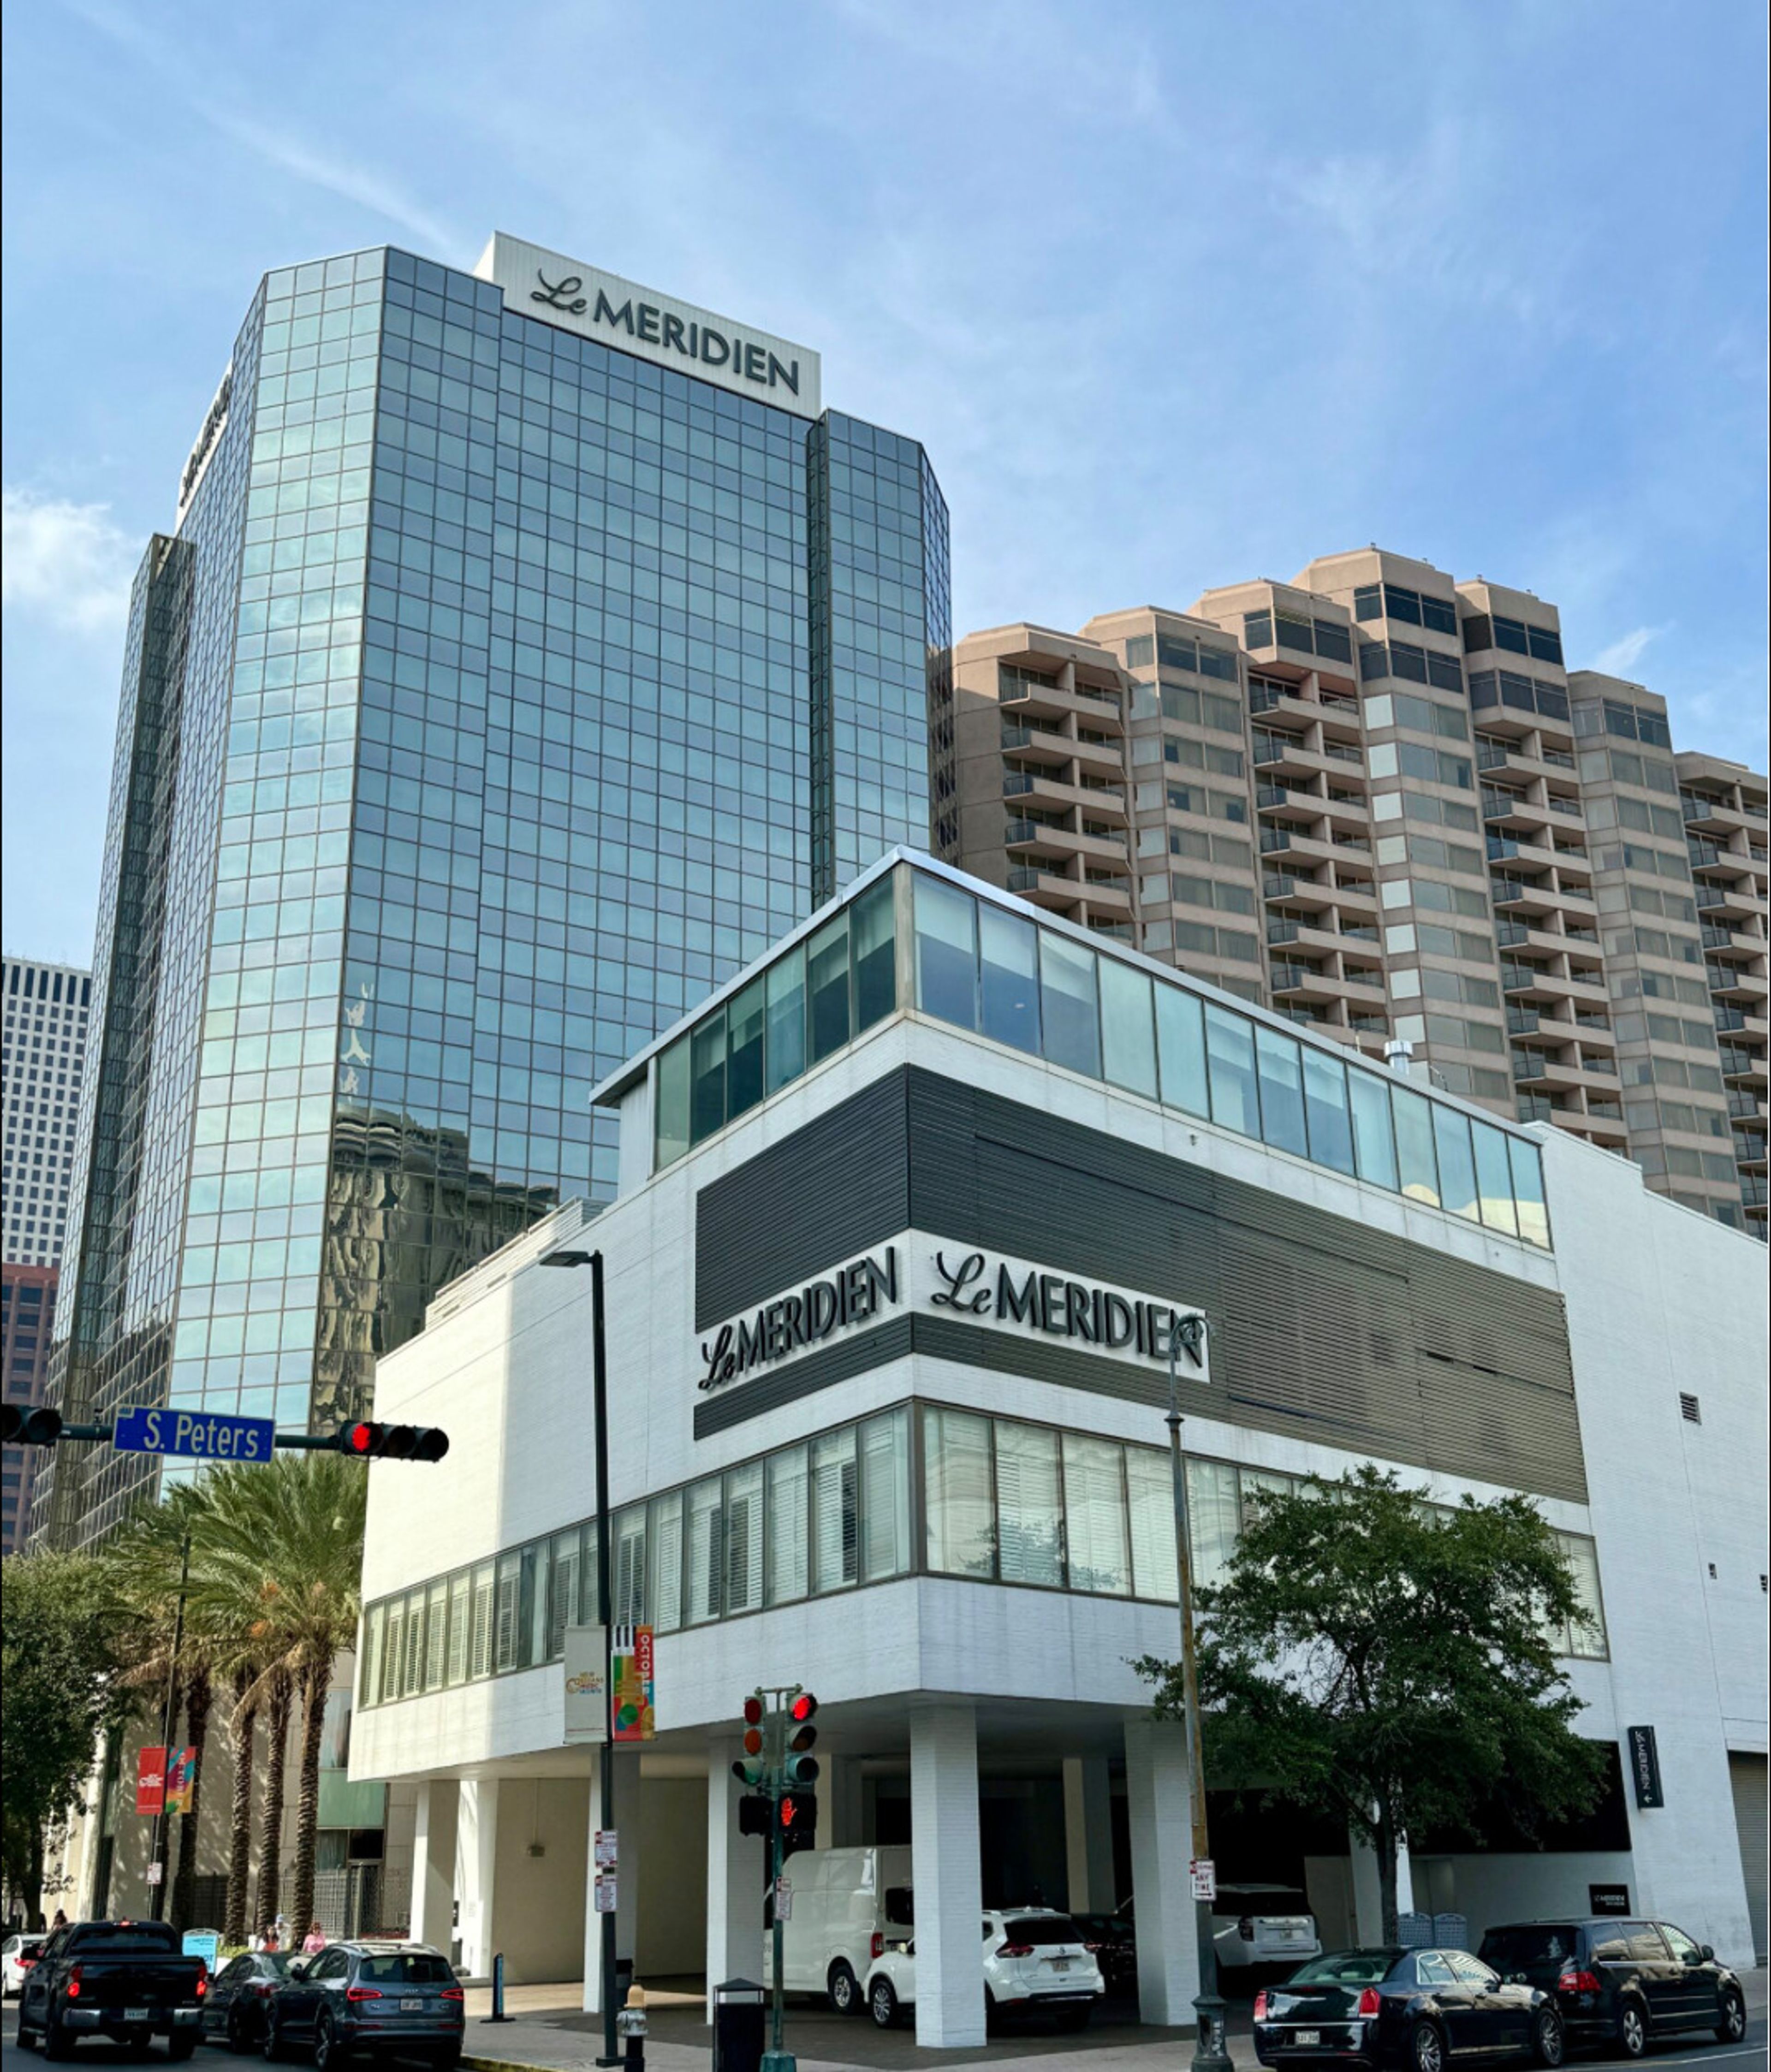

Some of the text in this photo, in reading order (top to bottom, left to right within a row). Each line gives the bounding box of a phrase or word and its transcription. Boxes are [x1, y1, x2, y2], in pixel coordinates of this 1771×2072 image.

[530, 268, 800, 397] Le MERIDIEN
[698, 1246, 896, 1389] Le MERIDIEN
[931, 1251, 1203, 1368] Le MERIDIEN
[143, 1412, 259, 1458] S. Peters
